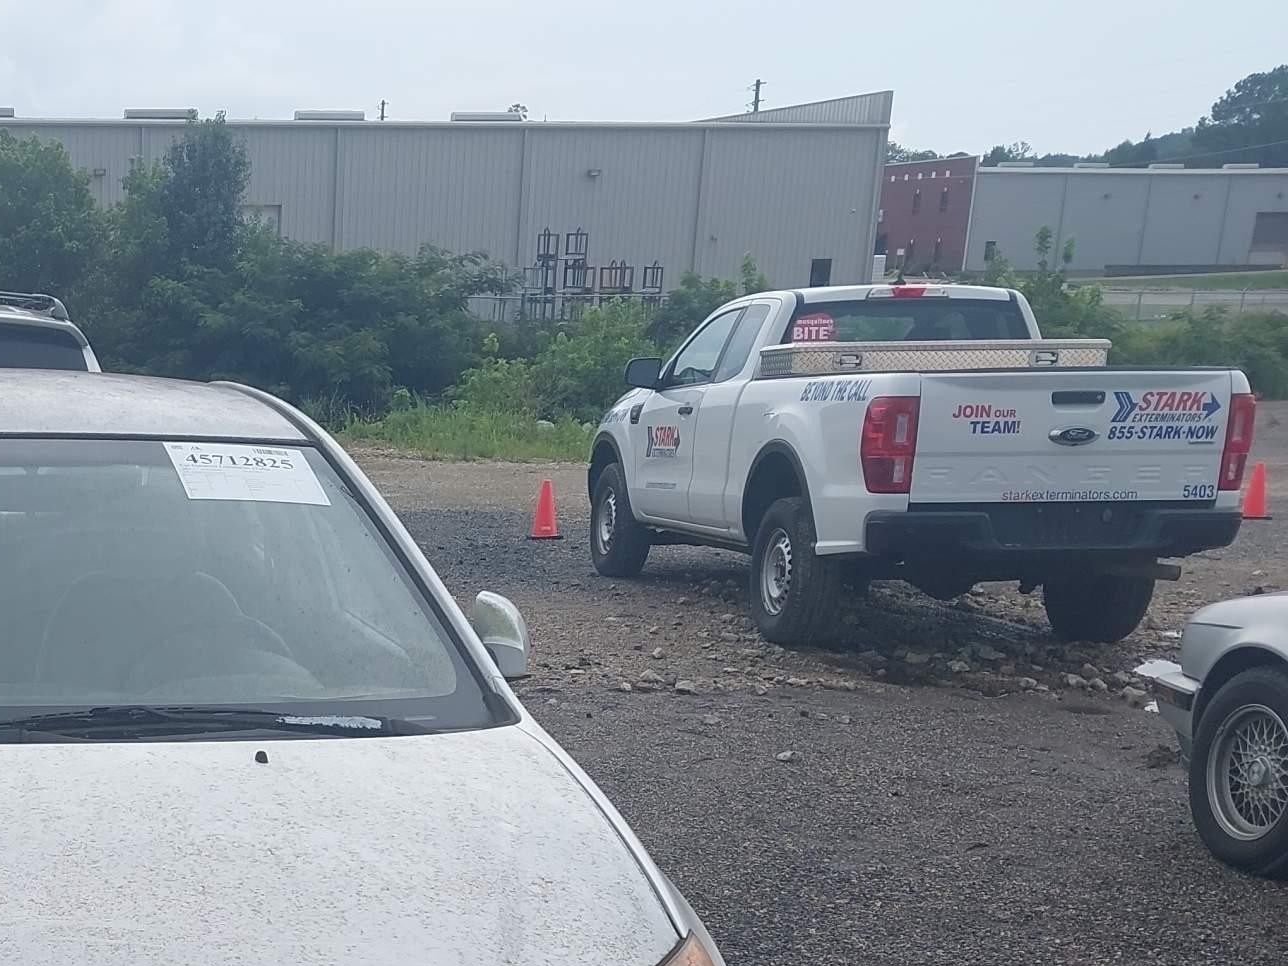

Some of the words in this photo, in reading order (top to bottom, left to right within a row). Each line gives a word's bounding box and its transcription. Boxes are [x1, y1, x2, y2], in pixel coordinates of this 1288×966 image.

[793, 326, 829, 340] BITE
[800, 381, 835, 401] BEYOND
[831, 380, 852, 401] THE
[848, 379, 872, 401] CALL
[1138, 391, 1207, 412] STARK
[952, 404, 992, 420] JOIN
[994, 408, 1016, 418] OUR
[1132, 413, 1203, 423] EXTERMINATORS
[970, 420, 1021, 435] TEAM!
[1107, 425, 1219, 440] 855-STARK-NOW
[654, 425, 677, 447] STARK
[185, 453, 295, 470] 45712825
[1001, 488, 1138, 502] starkexterminators.com
[1182, 484, 1215, 499] 5403
